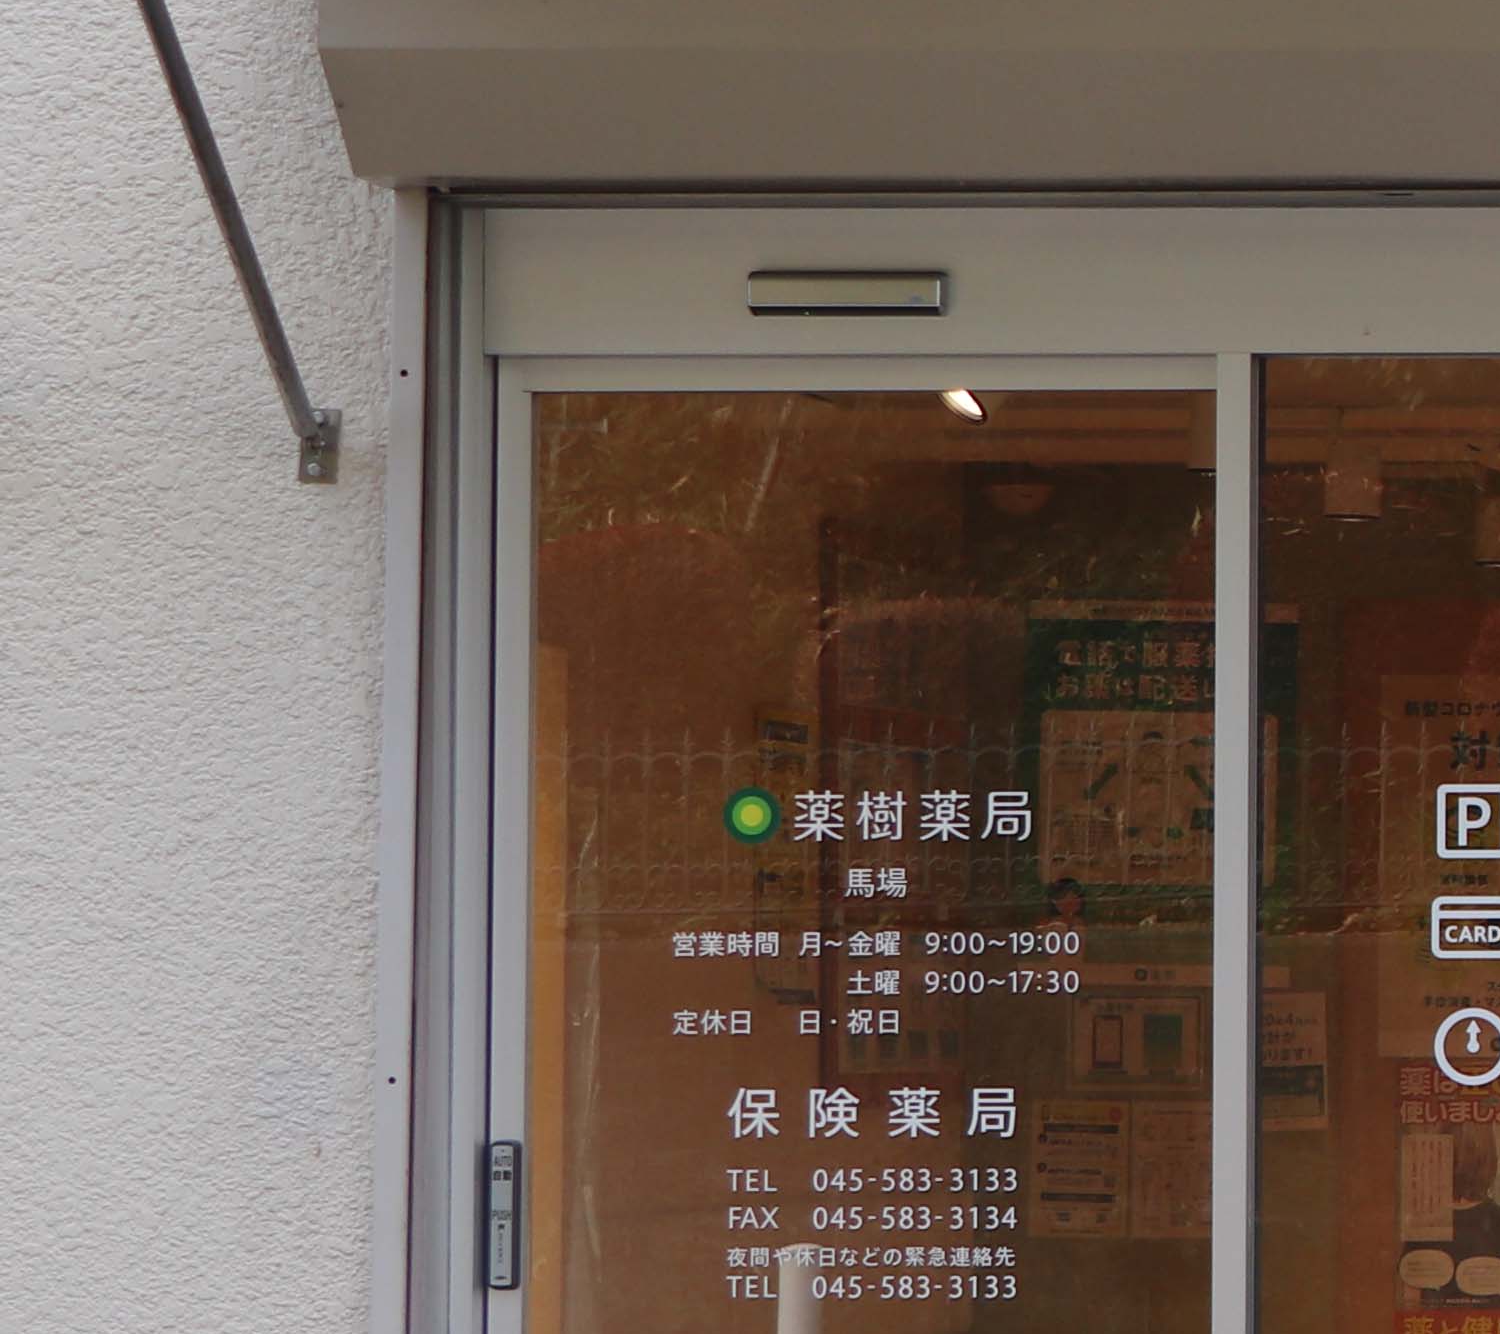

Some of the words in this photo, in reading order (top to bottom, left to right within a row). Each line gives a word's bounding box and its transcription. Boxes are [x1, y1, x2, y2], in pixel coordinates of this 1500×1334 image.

[793, 790, 1034, 842] 薬樹薬局
[845, 867, 909, 898] 馬場
[671, 931, 781, 958] 営業時間
[924, 931, 1080, 957] 9:00～19:00
[846, 970, 902, 995] 土曜
[924, 970, 1080, 994] 9:00～17:30
[672, 1009, 753, 1036] 定休日
[798, 1009, 901, 1035] 日・祝日
[727, 1086, 1018, 1140] 保険薬局
[727, 1169, 778, 1193] TEL
[812, 1168, 1018, 1193] 045-583-3133
[727, 1206, 780, 1230] FAX
[812, 1206, 1018, 1230] 045-583-3134
[725, 1245, 1017, 1268] 夜間や休日などの緊急連絡先
[727, 1275, 777, 1300] TEL
[811, 1275, 1018, 1300] 045-583-3133
